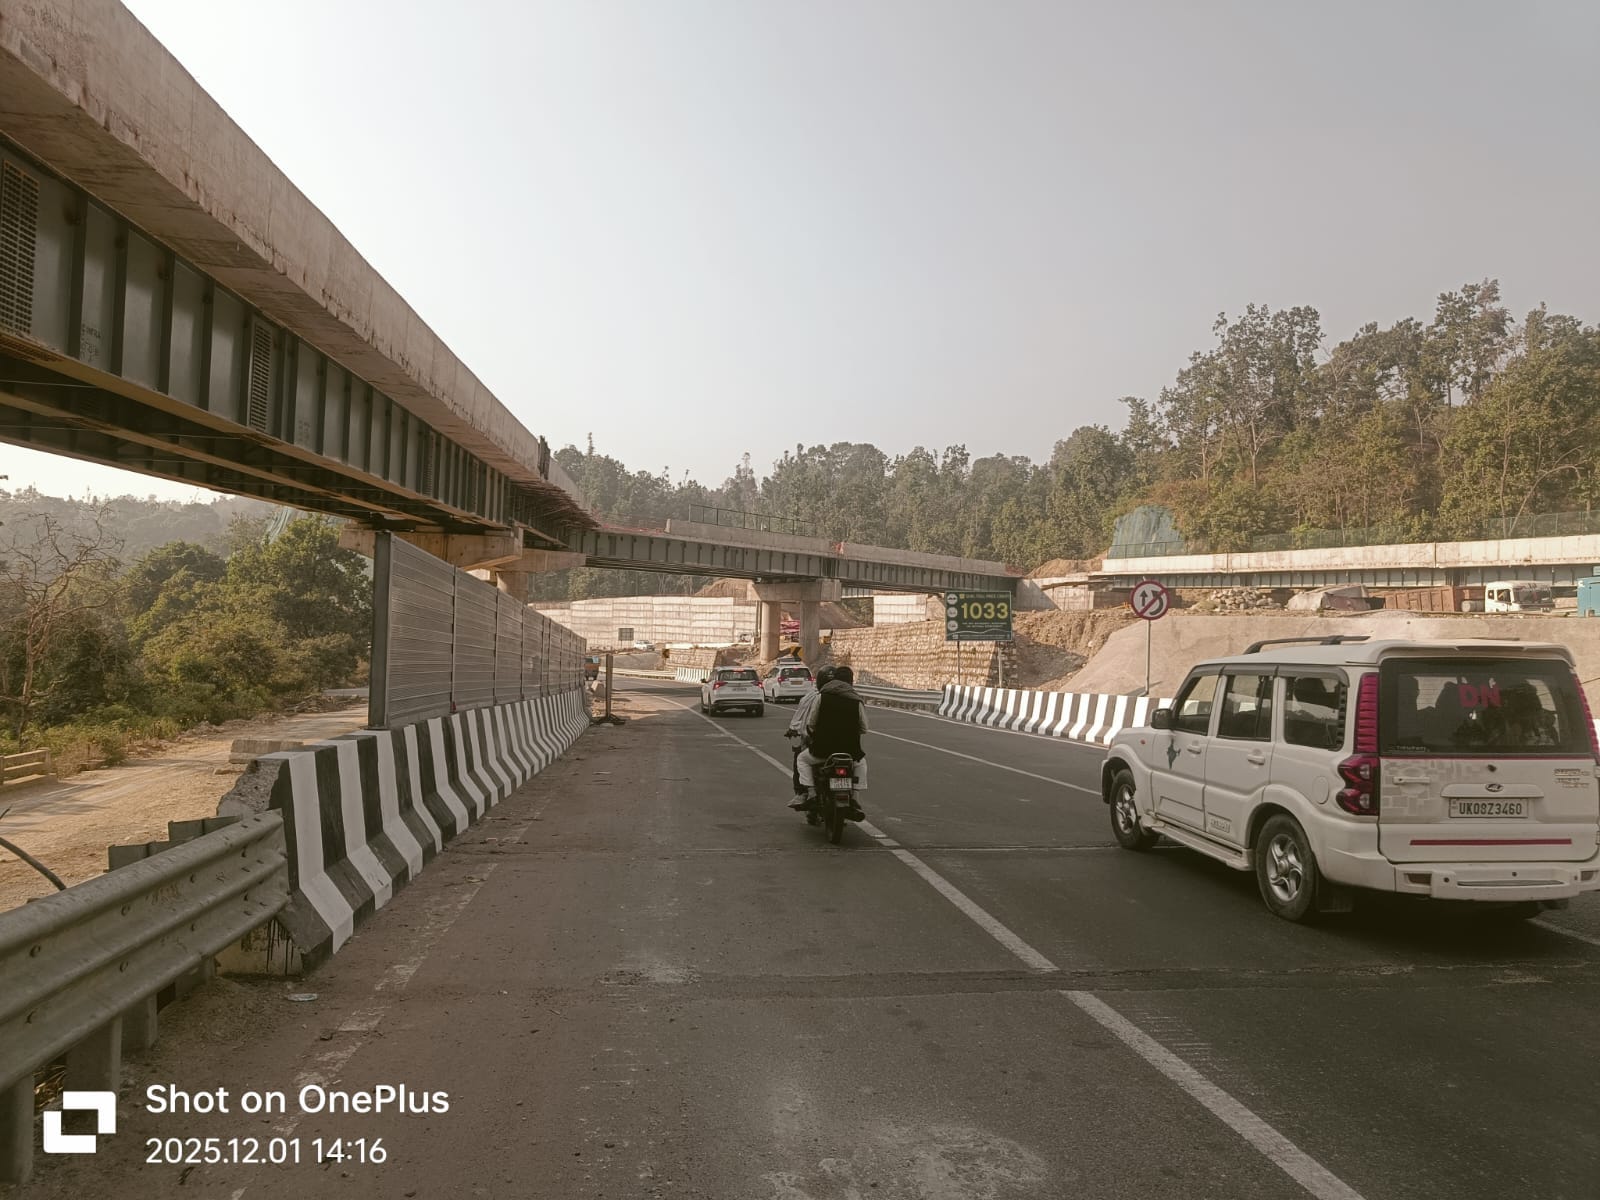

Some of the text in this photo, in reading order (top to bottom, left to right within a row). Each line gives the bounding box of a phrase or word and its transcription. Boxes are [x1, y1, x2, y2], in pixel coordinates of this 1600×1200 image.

[961, 602, 1008, 619] 1033
[1459, 683, 1502, 708] DN
[1459, 802, 1522, 815] UK08Z3460
